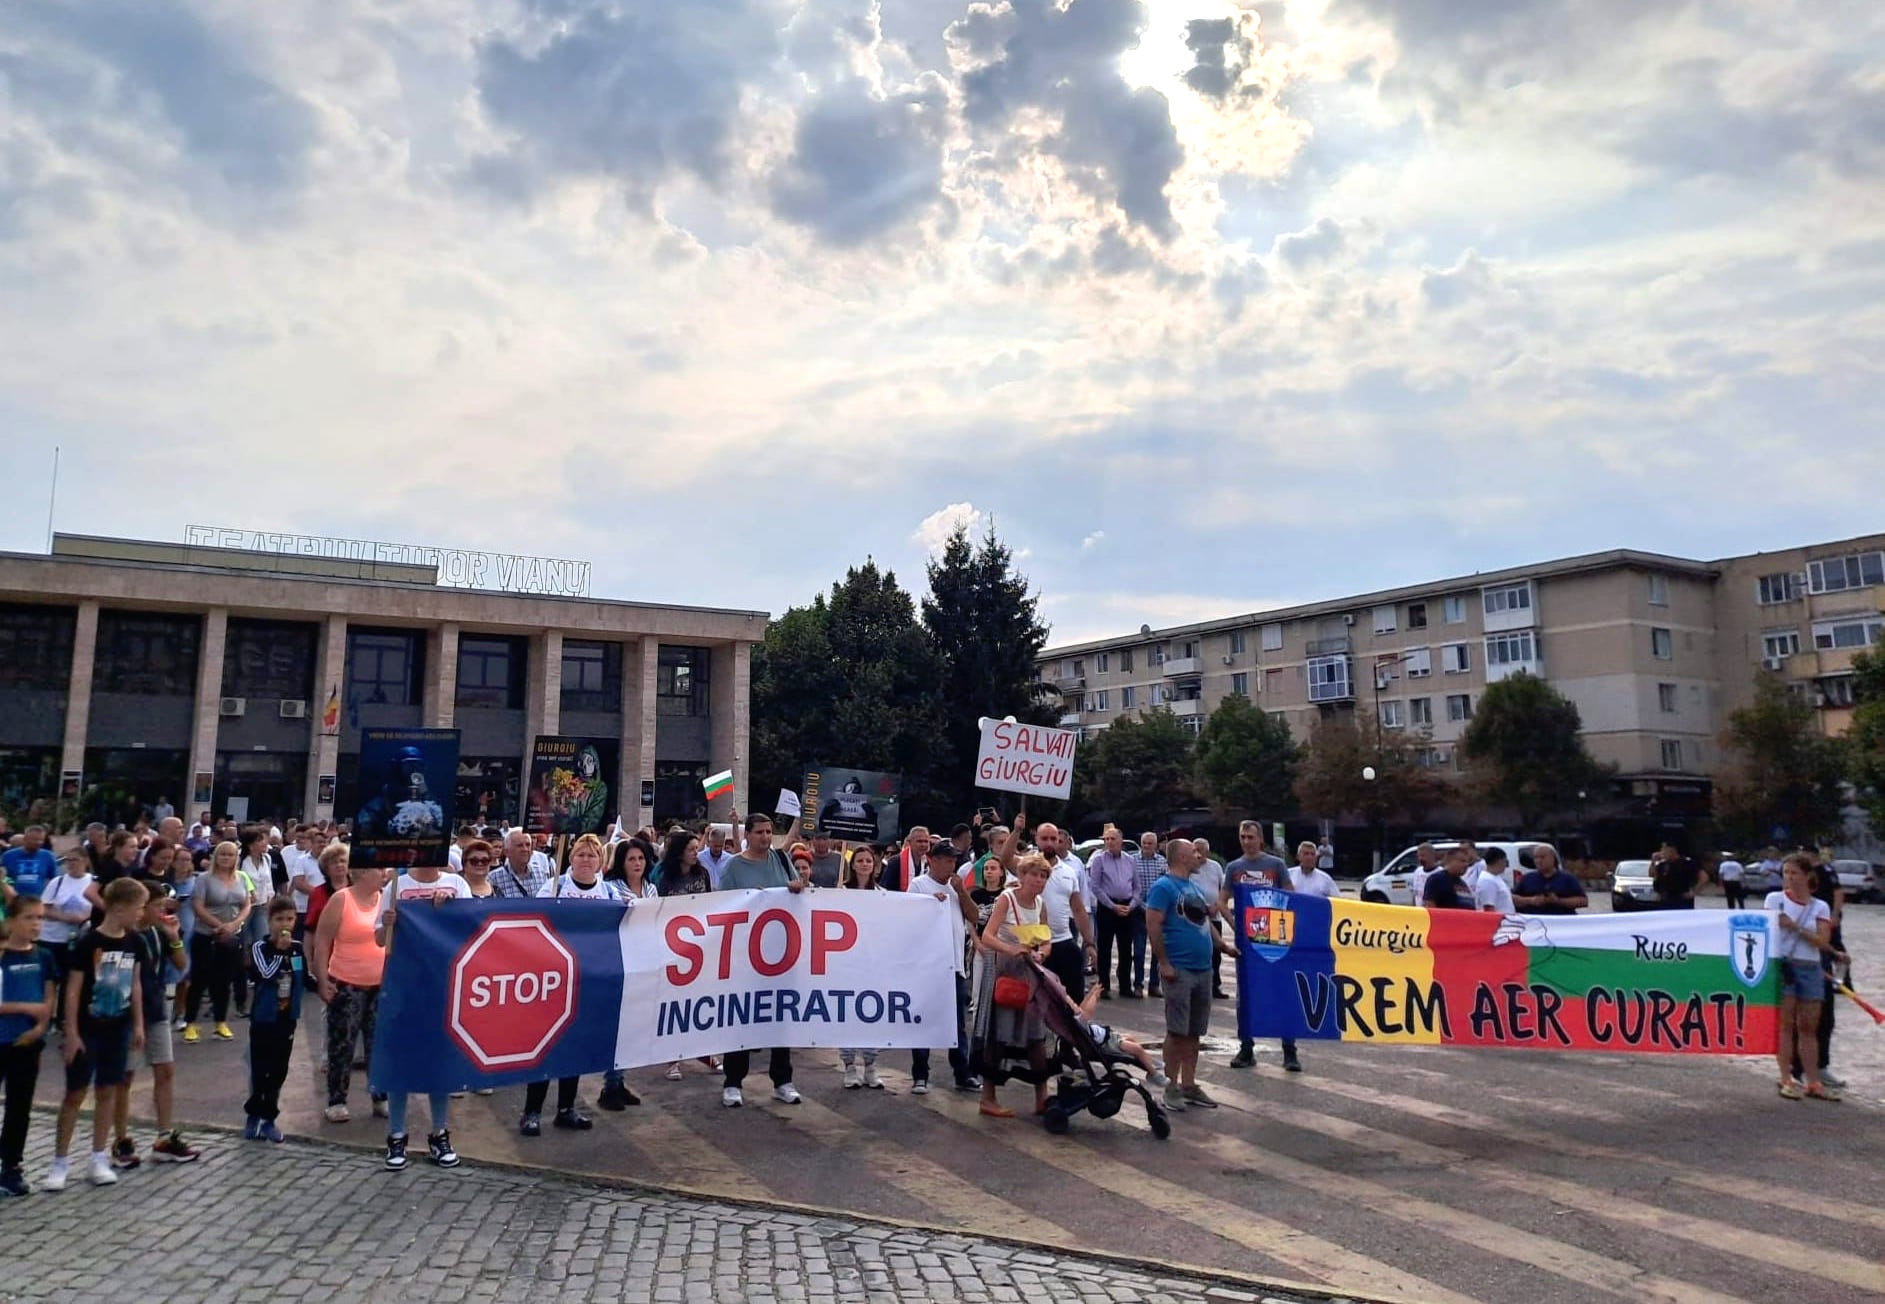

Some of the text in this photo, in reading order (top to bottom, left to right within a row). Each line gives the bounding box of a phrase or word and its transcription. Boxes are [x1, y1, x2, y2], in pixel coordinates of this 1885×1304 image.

[495, 553, 589, 593] VIANU
[994, 722, 1075, 759] SALVATI
[664, 908, 858, 986] STOP
[1336, 918, 1423, 953] Giurgiu
[1631, 934, 1688, 961] Ruse
[470, 971, 562, 1008] STOP
[656, 990, 922, 1037] INCINERATOR.
[1294, 971, 1747, 1050] VREM AER CURAT!
